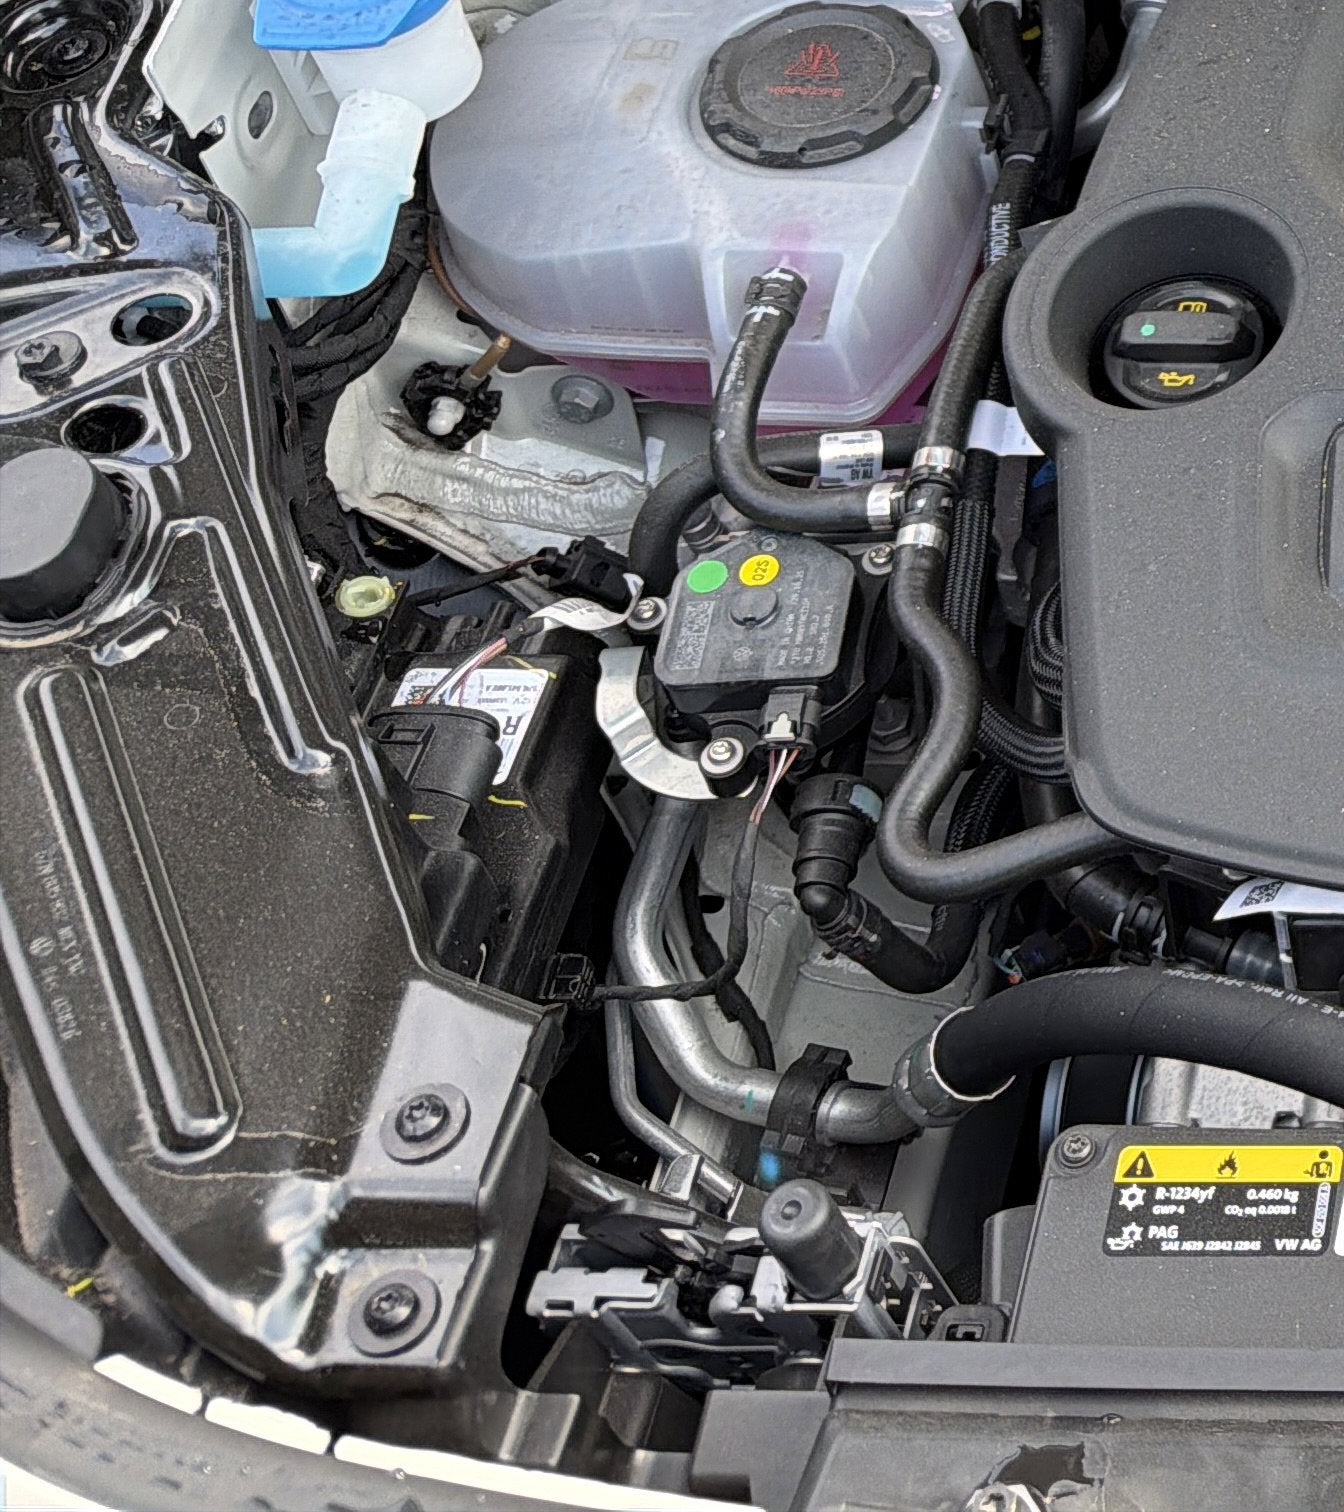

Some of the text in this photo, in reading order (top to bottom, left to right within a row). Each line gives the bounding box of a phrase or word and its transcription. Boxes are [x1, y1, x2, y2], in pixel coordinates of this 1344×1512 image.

[502, 716, 523, 735] R
[1155, 1186, 1299, 1204] R-1234yf 0.460 kg
[1152, 1206, 1177, 1215] GWP
[1177, 1206, 1185, 1215] 4
[1149, 1225, 1179, 1238] PAG
[1161, 1241, 1180, 1251] SAE
[1275, 1239, 1299, 1251] VW
[1300, 1239, 1322, 1251] AG
